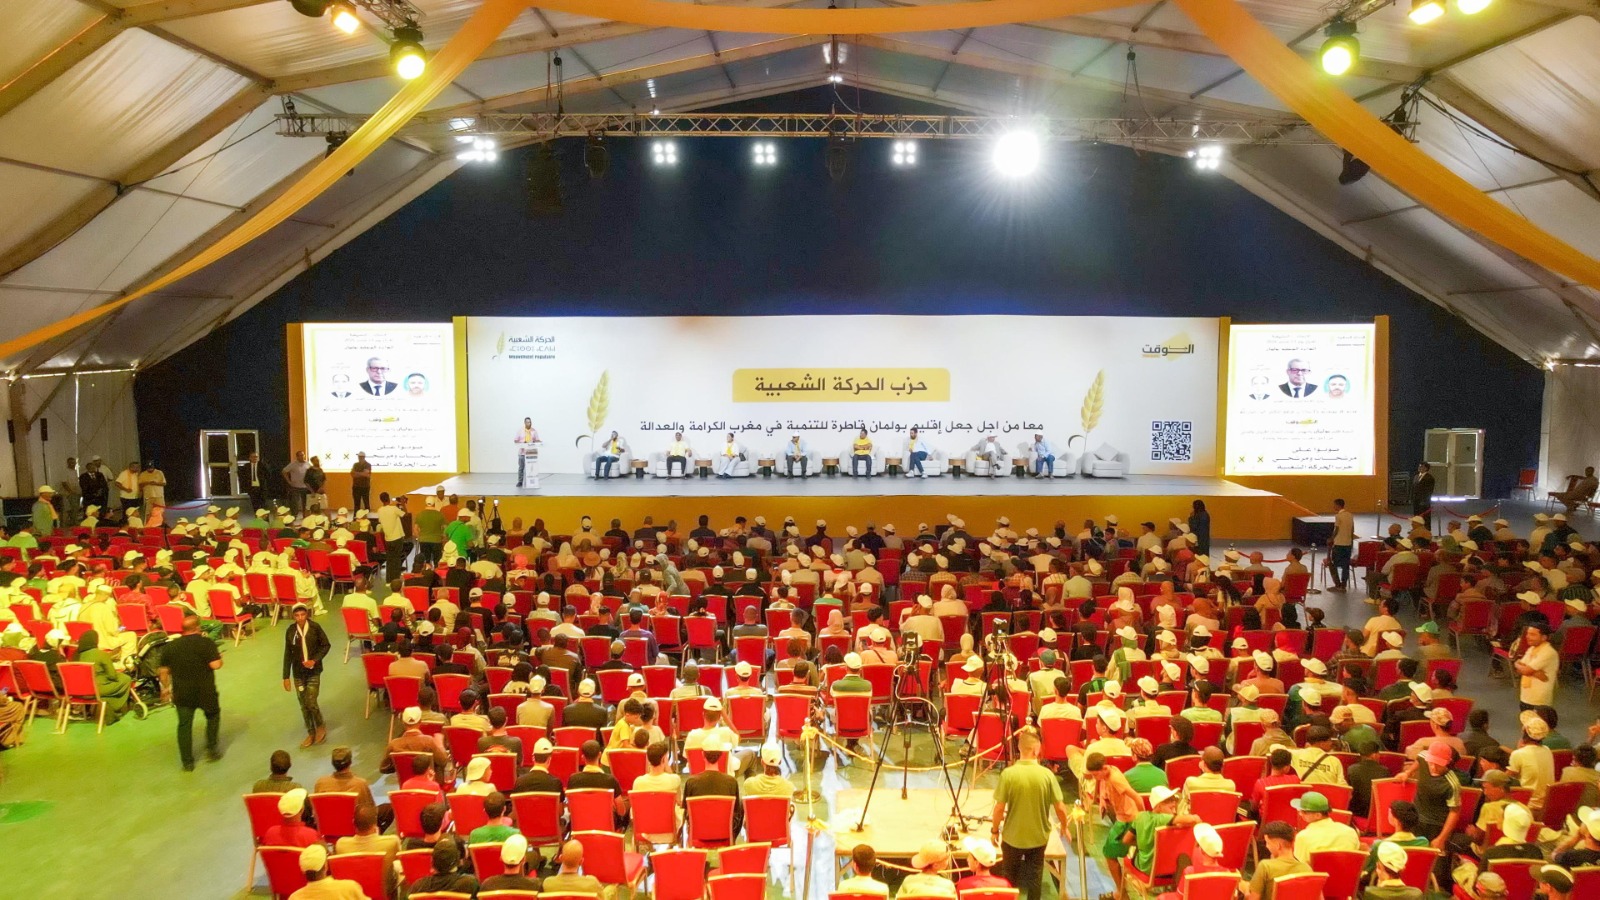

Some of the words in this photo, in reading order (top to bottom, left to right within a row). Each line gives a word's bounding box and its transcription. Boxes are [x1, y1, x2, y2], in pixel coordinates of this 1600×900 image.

[754, 373, 826, 397] الشعبية
[832, 376, 885, 396] الحركة
[890, 376, 928, 396] حزب
[640, 420, 685, 434] والعدالة
[688, 420, 726, 433] الكرامة
[728, 421, 763, 434] مغرب
[765, 420, 783, 436] في
[786, 420, 829, 433] للتنمية
[831, 420, 866, 433] قاطرة
[869, 420, 908, 434] بولمان
[911, 420, 942, 434] إقليم
[944, 420, 974, 433] جعل
[976, 420, 999, 433] اجل
[1002, 420, 1020, 433] من
[1022, 420, 1044, 431] معا
